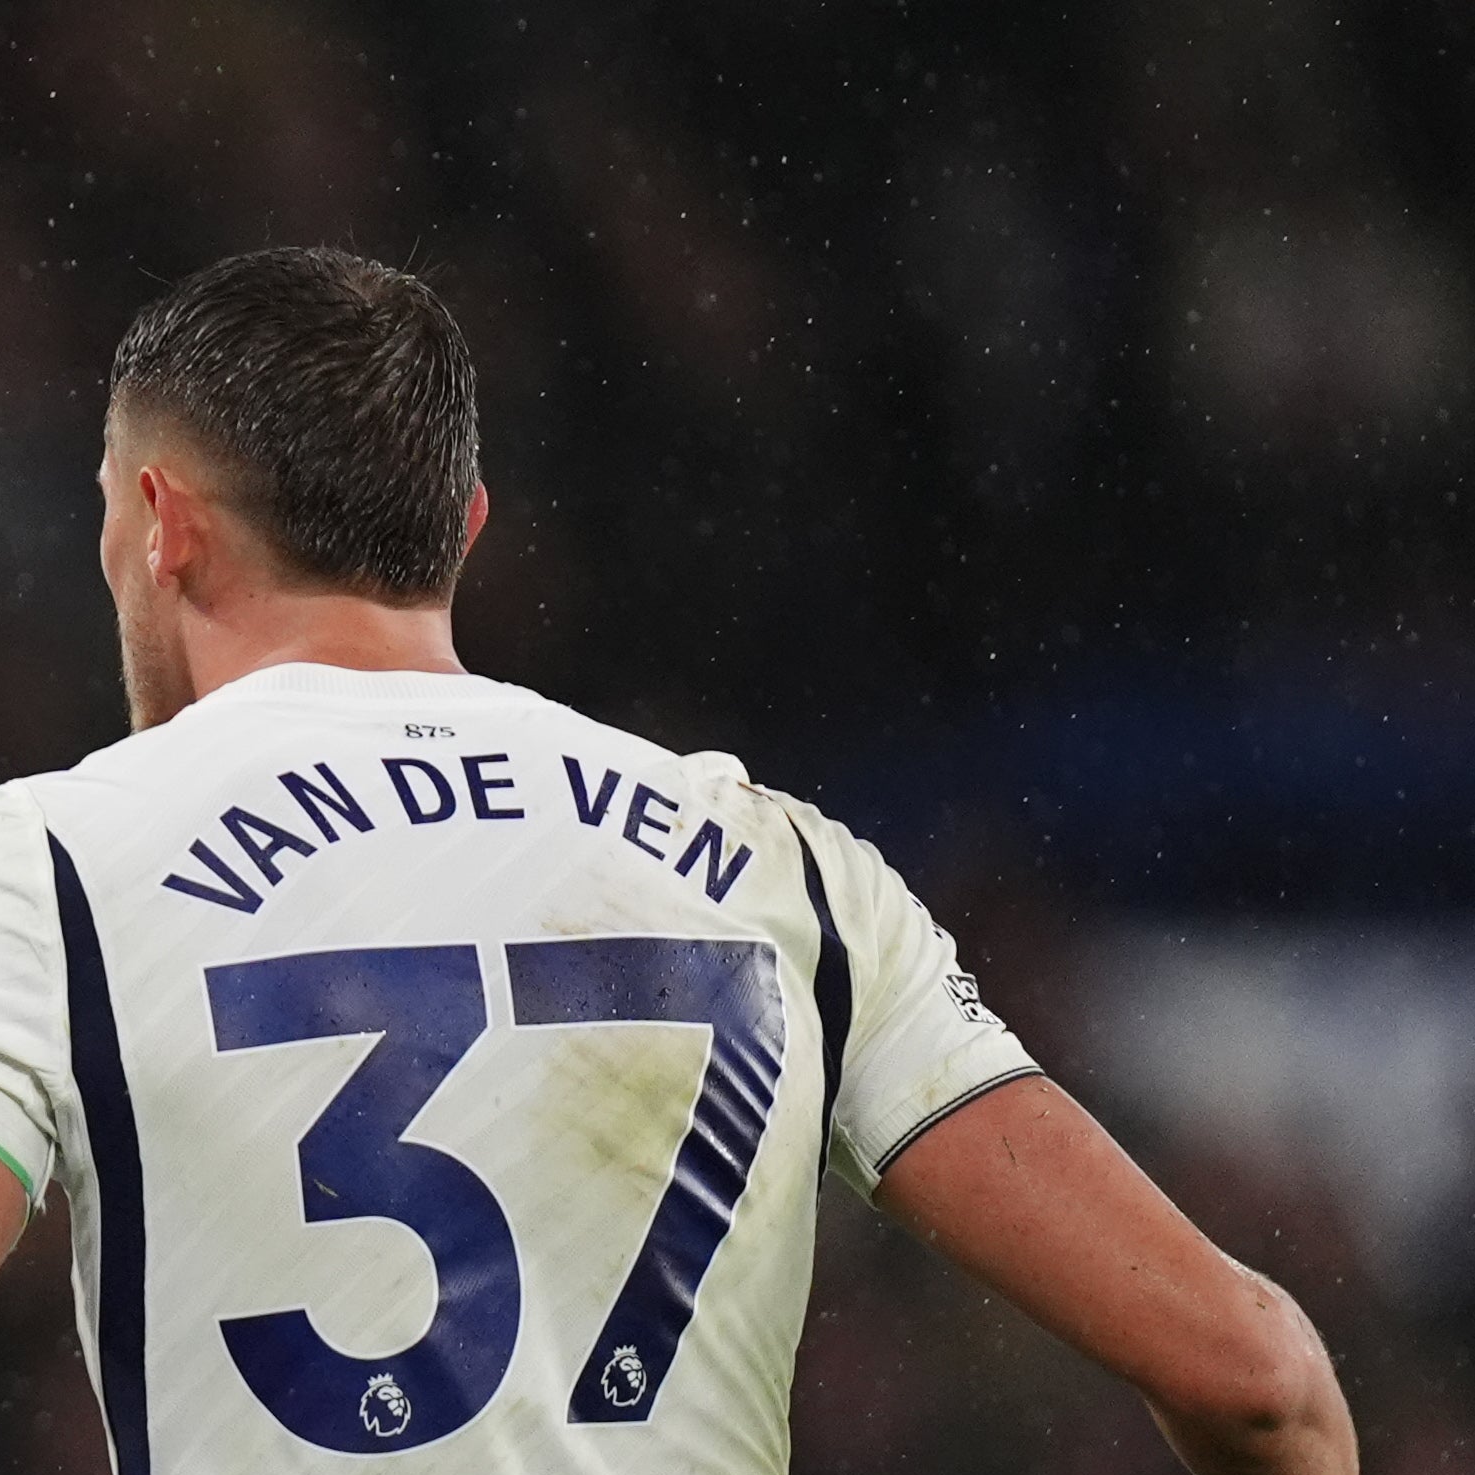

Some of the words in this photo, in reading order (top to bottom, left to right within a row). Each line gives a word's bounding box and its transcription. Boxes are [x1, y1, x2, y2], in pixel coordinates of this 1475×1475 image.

[405, 723, 455, 738] 875
[161, 762, 375, 915] VAN
[381, 753, 525, 825] DE
[561, 754, 753, 904] VEN
[942, 975, 978, 1000] No
[201, 933, 788, 1456] 37
